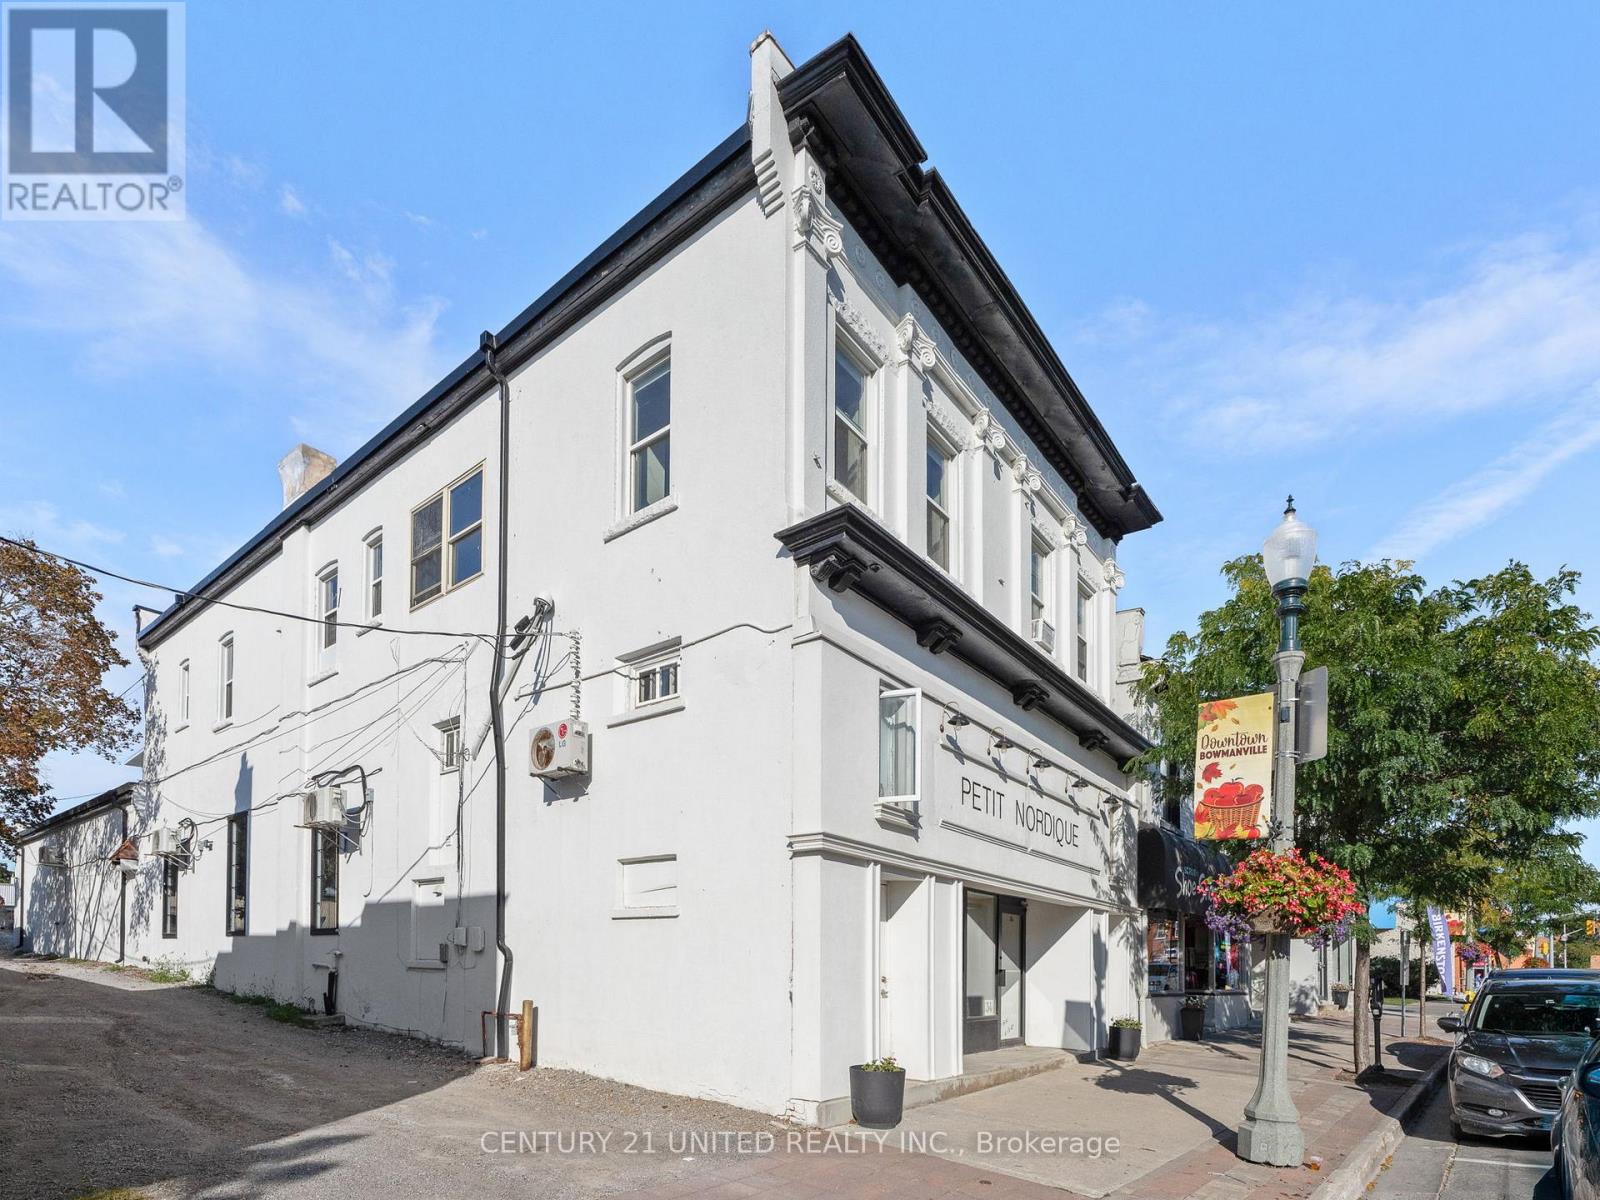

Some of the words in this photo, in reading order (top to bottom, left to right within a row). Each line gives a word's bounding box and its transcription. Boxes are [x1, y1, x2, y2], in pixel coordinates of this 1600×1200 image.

[1200, 731, 1268, 751] Downtown
[1200, 744, 1268, 761] BOWMANVILLE
[961, 776, 1005, 820] PETIT
[1015, 799, 1080, 848] NORDIQUE
